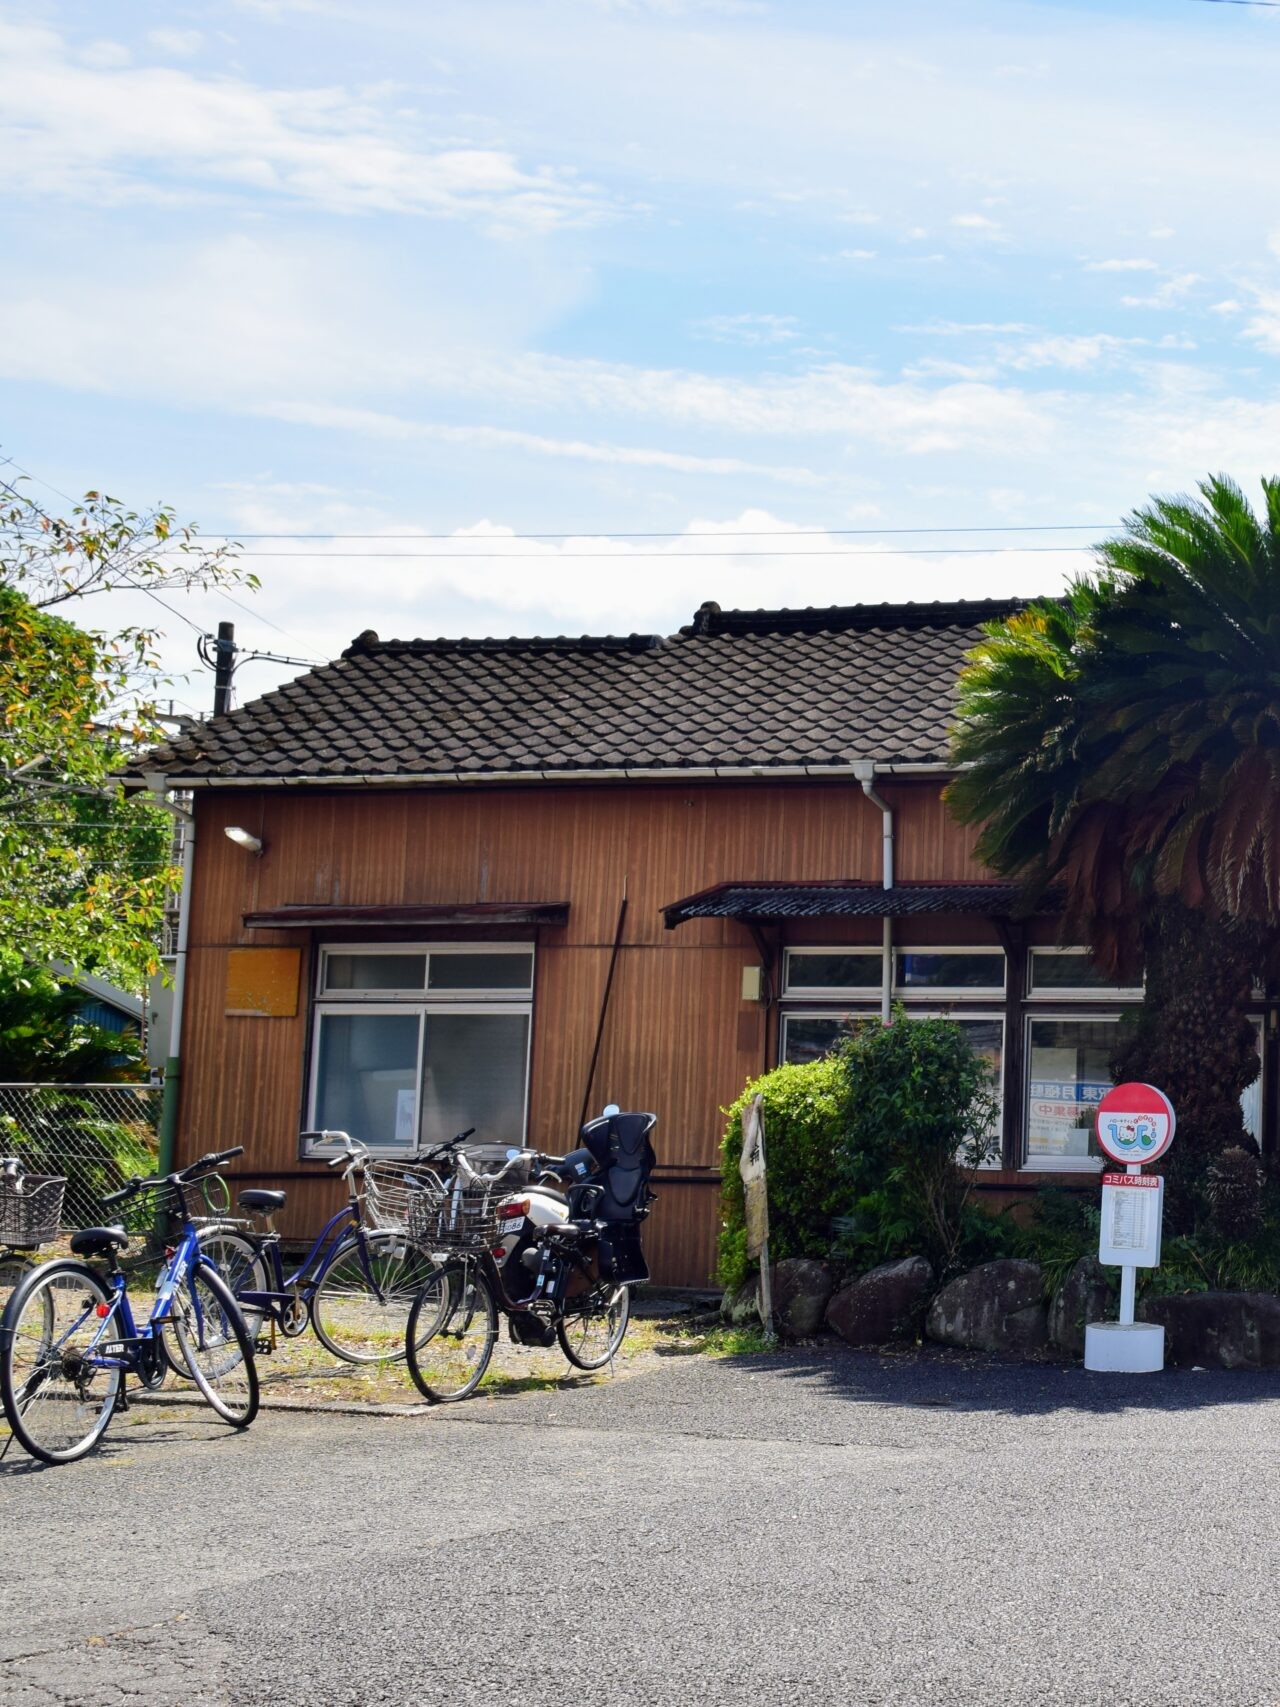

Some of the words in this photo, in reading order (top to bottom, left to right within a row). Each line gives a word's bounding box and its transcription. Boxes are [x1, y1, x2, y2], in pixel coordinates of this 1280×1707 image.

[1104, 1175, 1158, 1187] コミバス時刻表
[105, 1344, 125, 1354] ALTER
